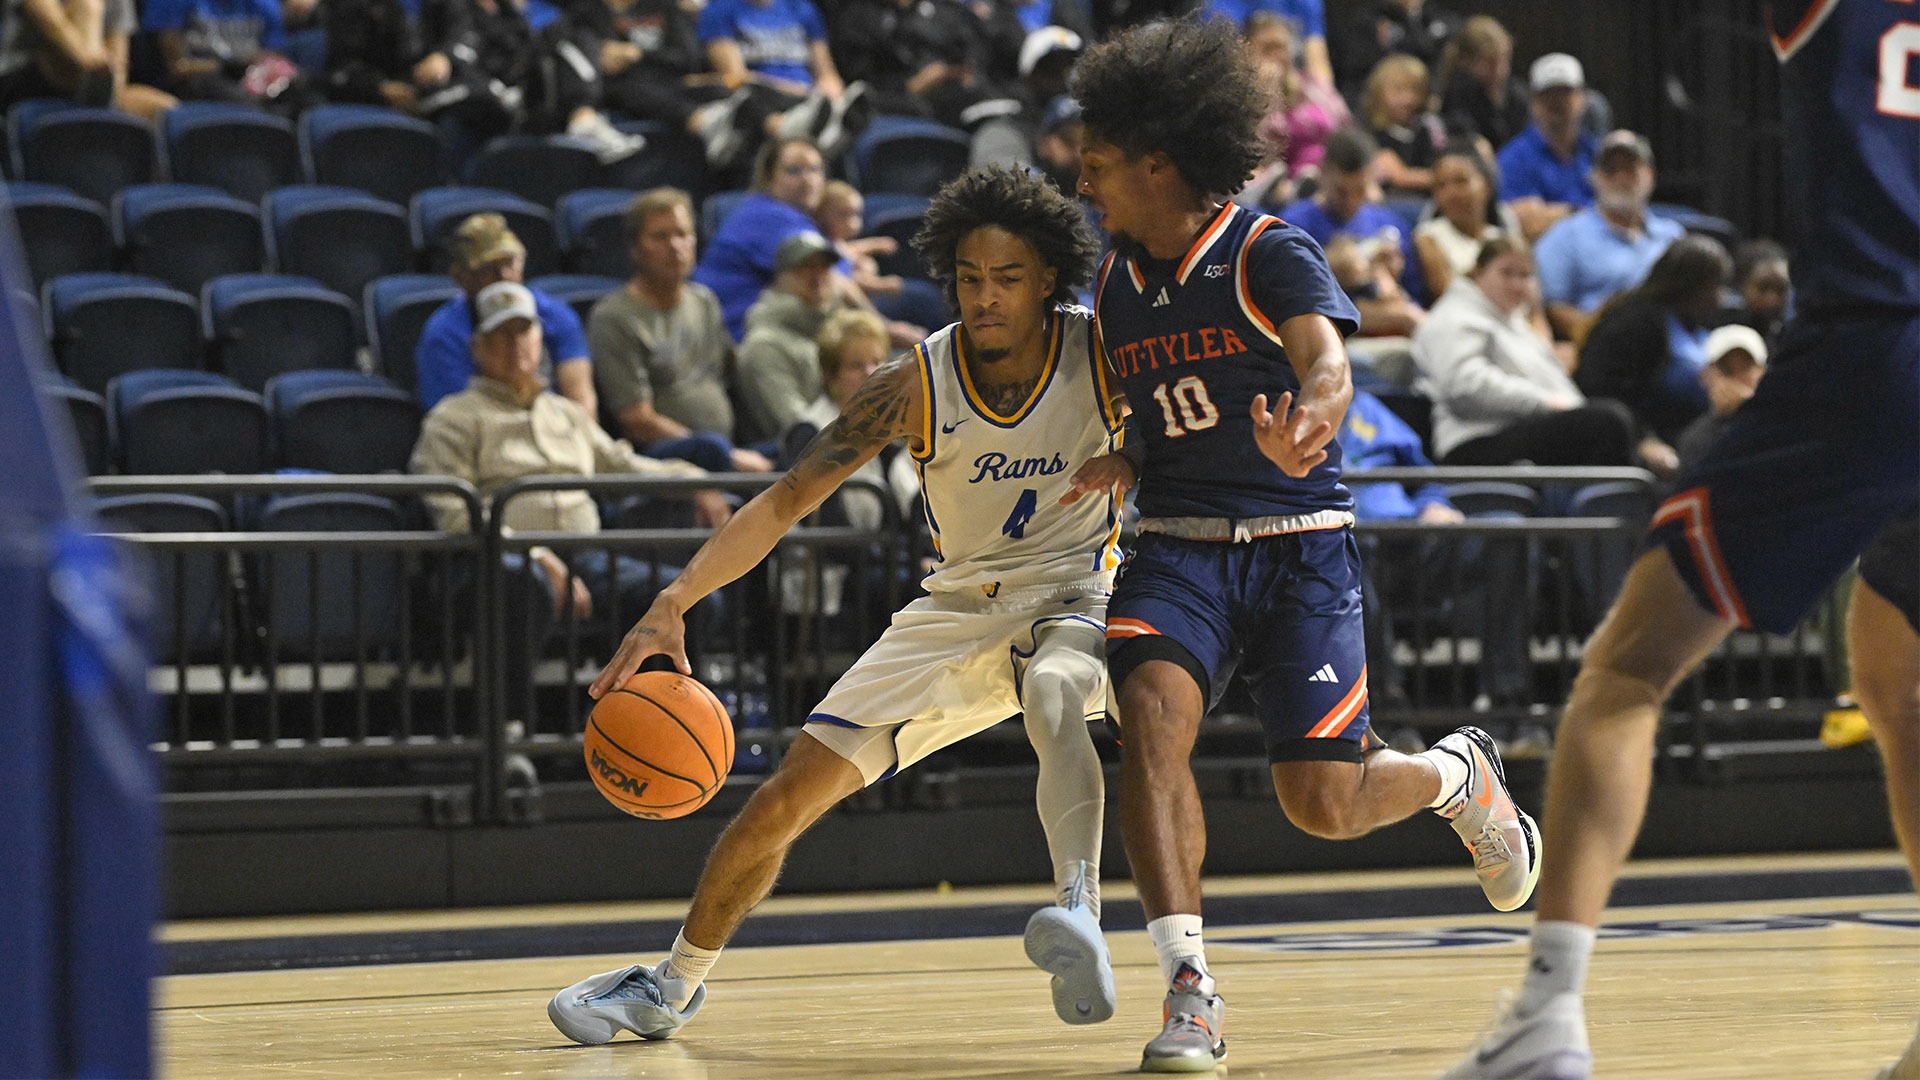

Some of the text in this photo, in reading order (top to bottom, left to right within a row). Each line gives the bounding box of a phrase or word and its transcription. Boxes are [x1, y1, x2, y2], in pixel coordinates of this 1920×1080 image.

[1204, 264, 1228, 279] LSC
[1153, 375, 1220, 438] 10
[968, 452, 1069, 484] Rams
[1002, 489, 1037, 539] 4
[591, 748, 649, 798] NCAA
